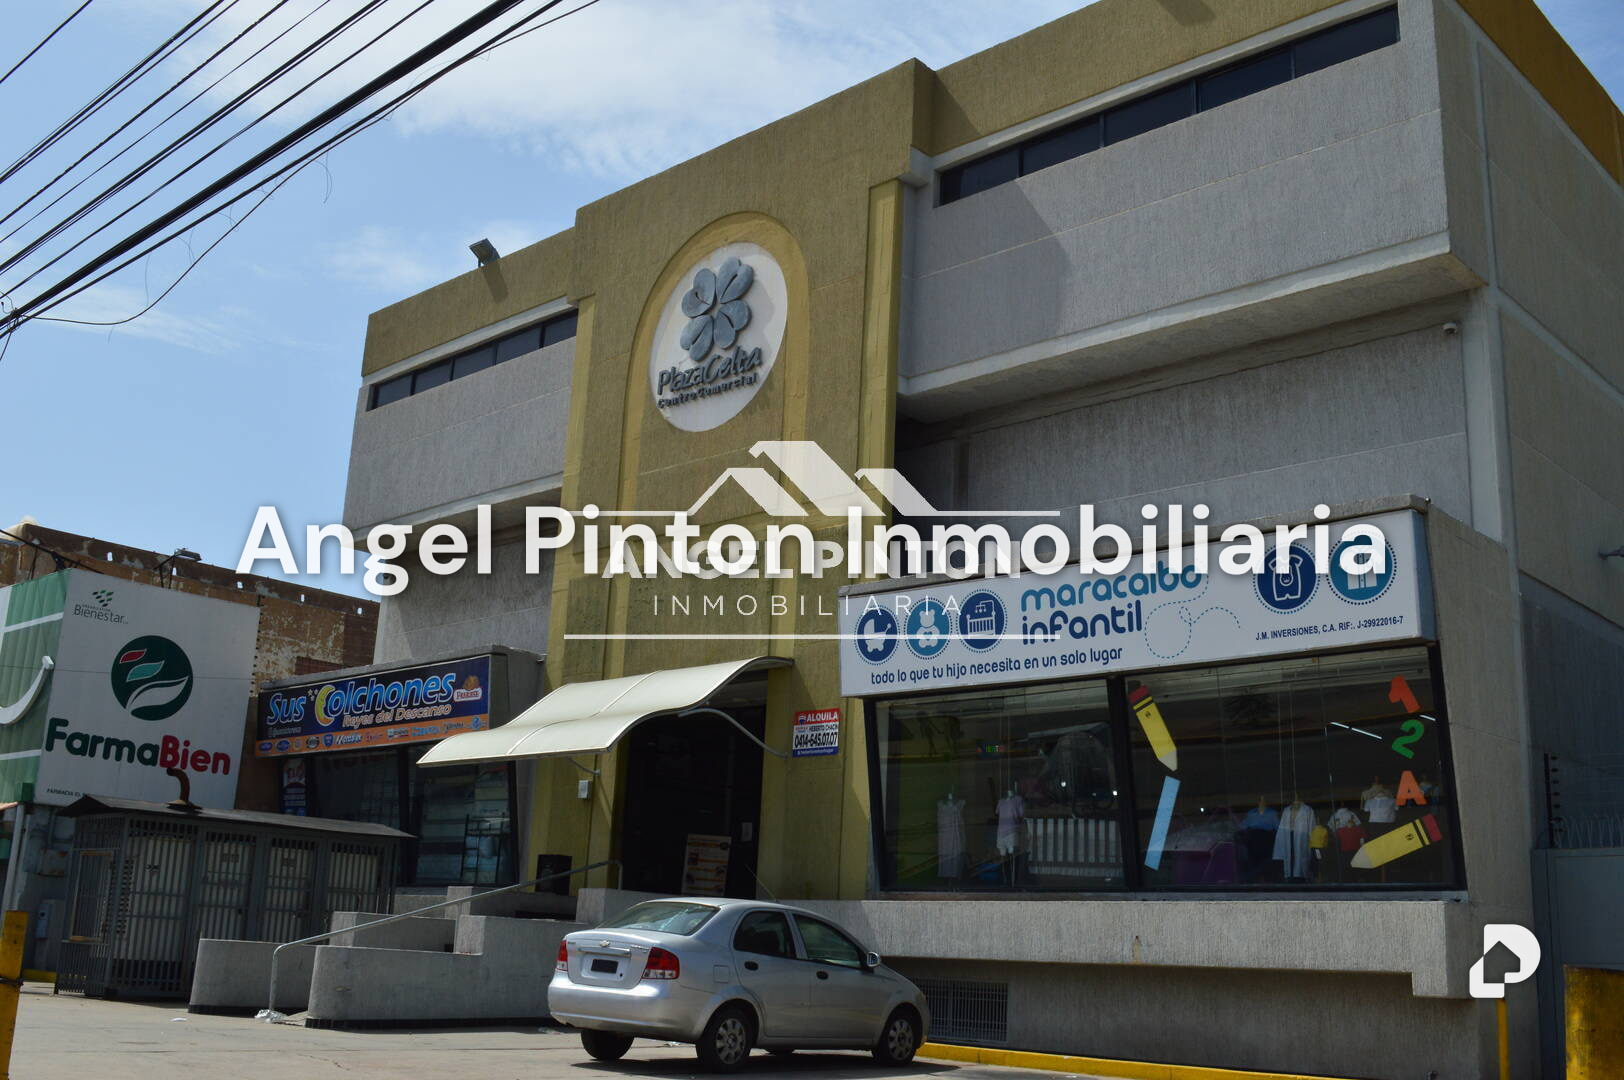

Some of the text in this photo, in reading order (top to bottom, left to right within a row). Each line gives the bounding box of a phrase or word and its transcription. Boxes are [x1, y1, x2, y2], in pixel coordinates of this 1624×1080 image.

[1021, 561, 1202, 612] maracaibo
[73, 604, 125, 623] Bienestar
[1022, 599, 1142, 645] infantil
[1255, 632, 1269, 640] J.M.
[1270, 625, 1321, 639] INVERSIONES,
[1322, 623, 1337, 633] C.A.
[1357, 615, 1404, 629] J-29922016-7
[871, 647, 1123, 685] todo lo que tu hijo necesita en un solo lugar
[266, 672, 457, 727] Sus Colchones
[1388, 675, 1421, 713] 1
[342, 704, 452, 729] Reyes del Descanso
[806, 711, 838, 722] ALQUILA
[45, 717, 231, 775] FarmaBien
[1392, 719, 1425, 759] 2
[1395, 770, 1427, 806] A
